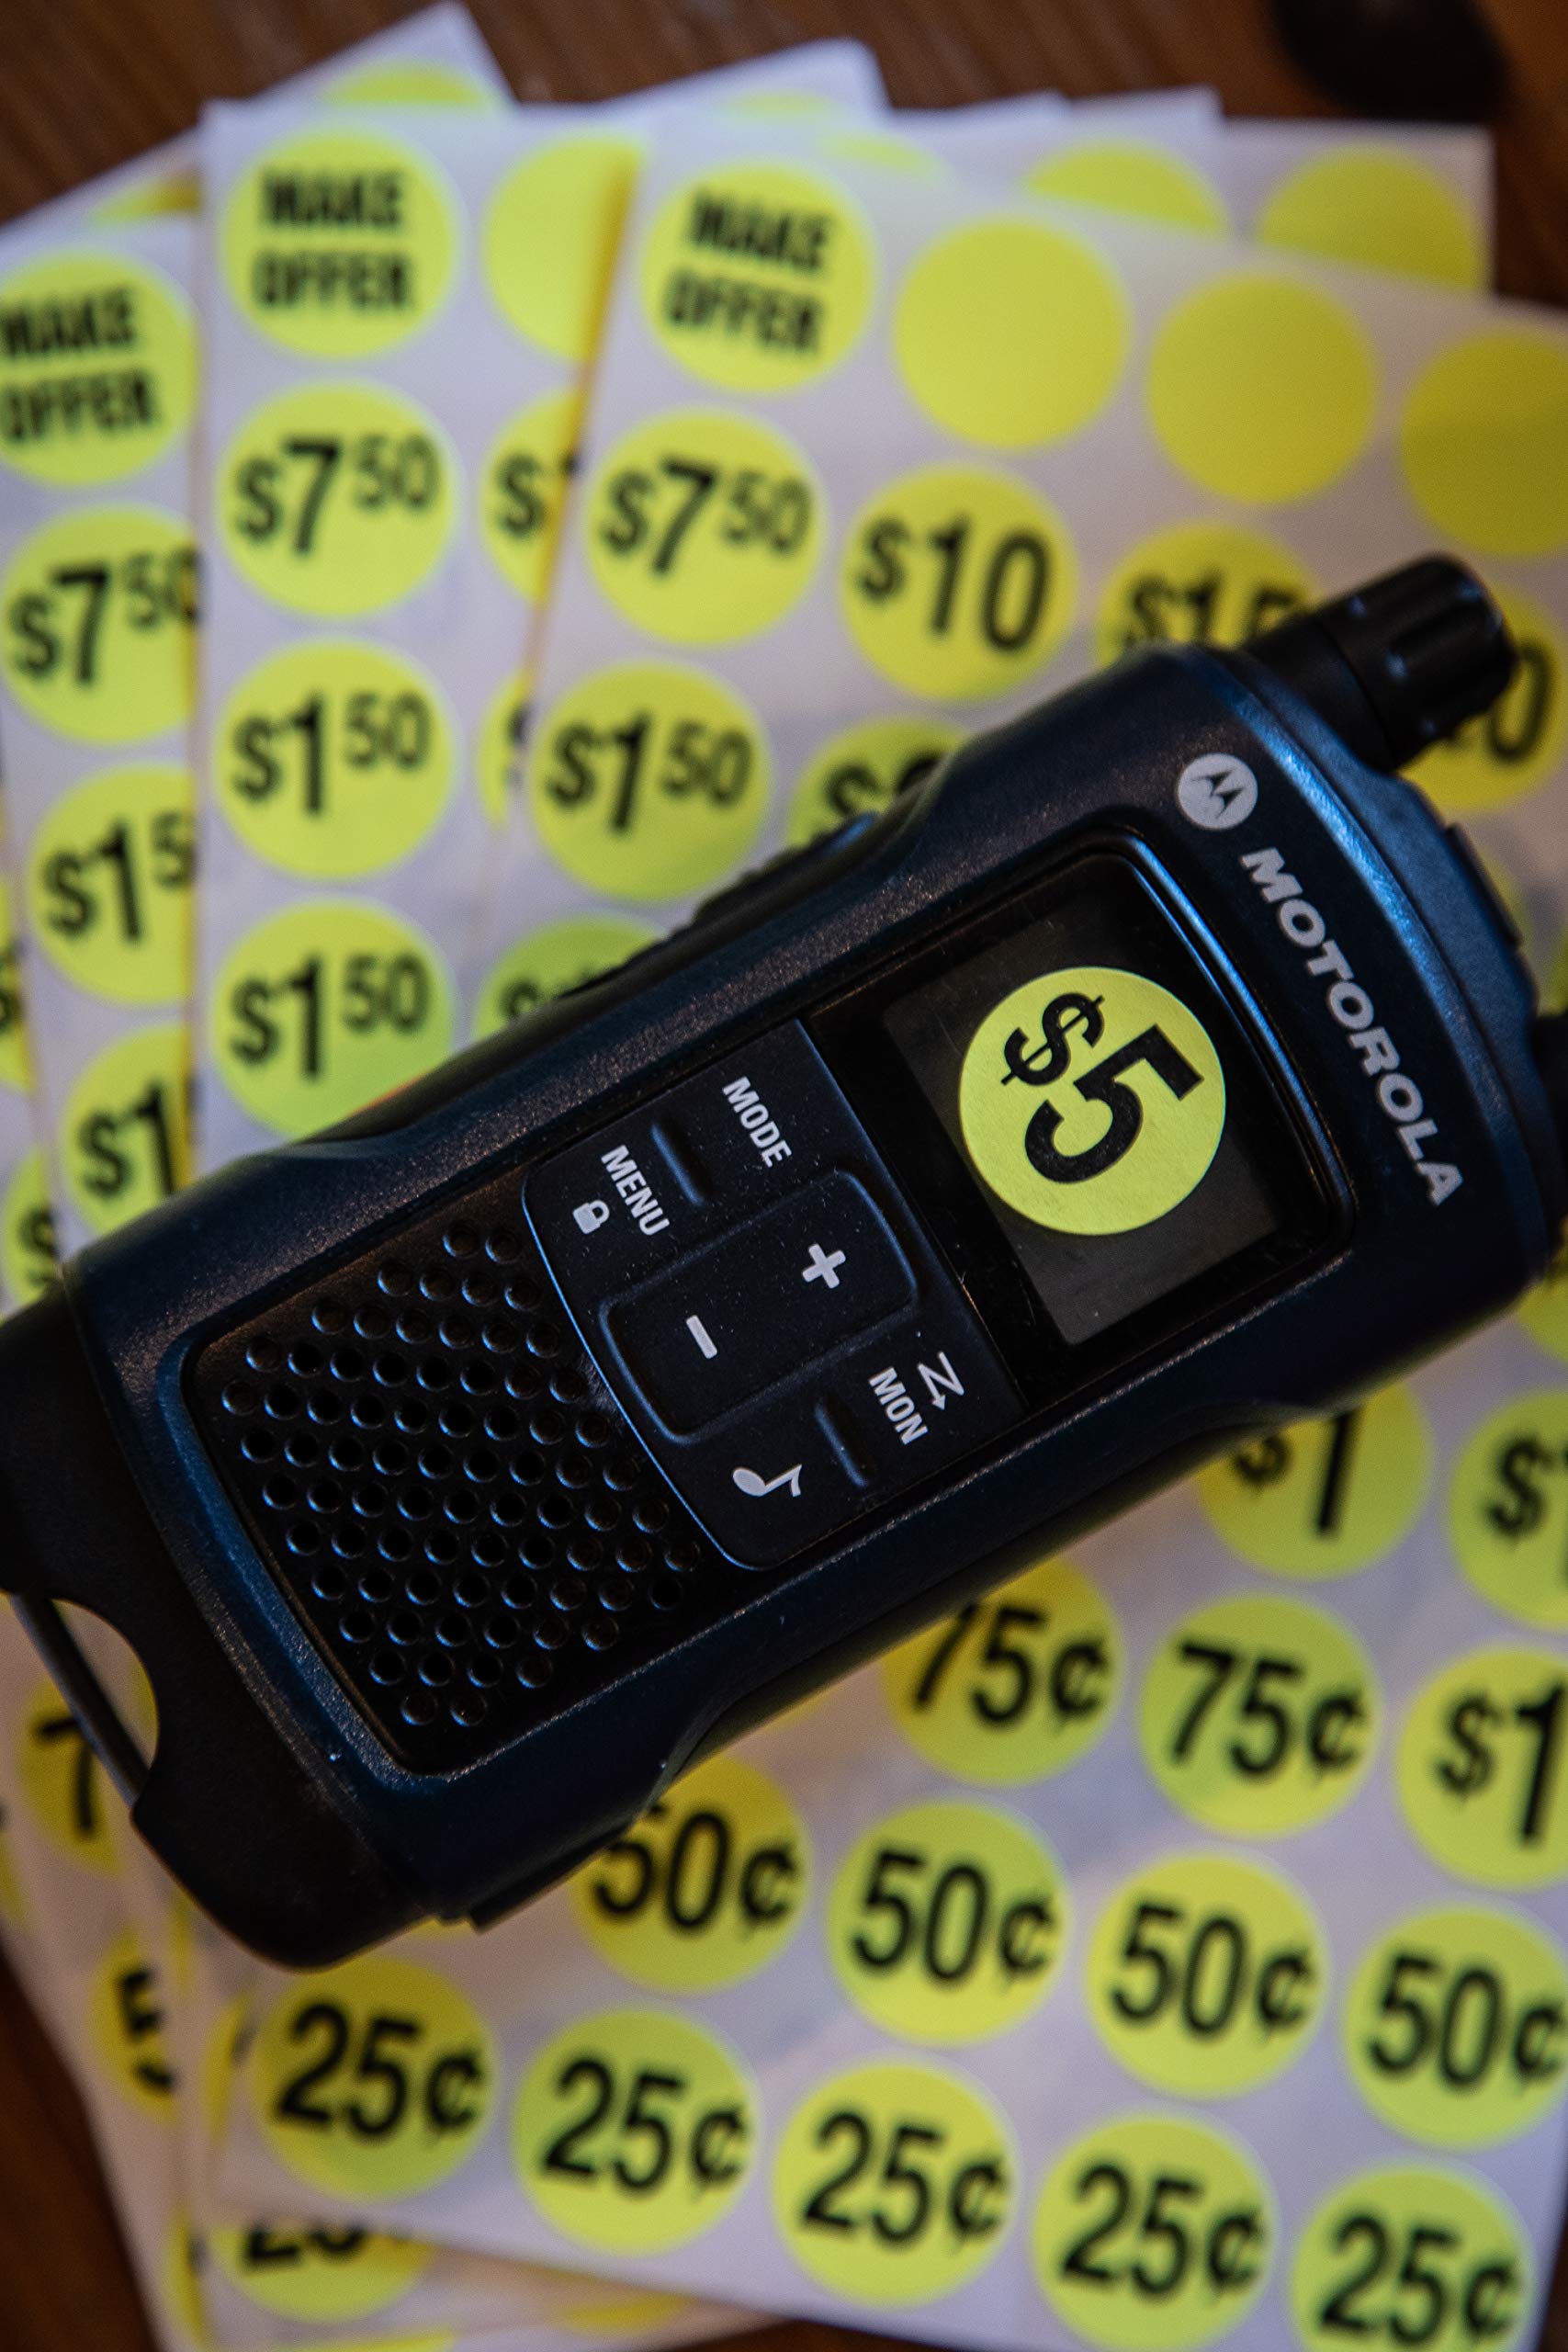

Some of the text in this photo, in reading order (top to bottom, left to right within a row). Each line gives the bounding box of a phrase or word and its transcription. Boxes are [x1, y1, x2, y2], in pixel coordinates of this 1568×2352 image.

[258, 170, 406, 229] MAKE
[692, 189, 831, 272] MAKE
[254, 250, 413, 311] OFFER
[666, 270, 824, 355] OFFER
[856, 511, 1052, 652] $10
[1000, 990, 1205, 1185] $5
[1241, 847, 1463, 1206] MOTOROLA
[601, 1145, 670, 1236] MENU
[722, 1076, 792, 1168] MODE
[869, 1366, 929, 1445] MON
[1171, 1635, 1368, 1782] 75¢
[852, 1845, 1056, 1992] 50¢
[1111, 1900, 1314, 2043] 50¢
[273, 1998, 488, 2148] 25¢
[1369, 1948, 1568, 2095] 50¢
[543, 2052, 748, 2201] 25¢
[801, 2110, 1007, 2256] 25¢
[1058, 2161, 1264, 2306] 25¢
[1318, 2212, 1518, 2350] 25¢
